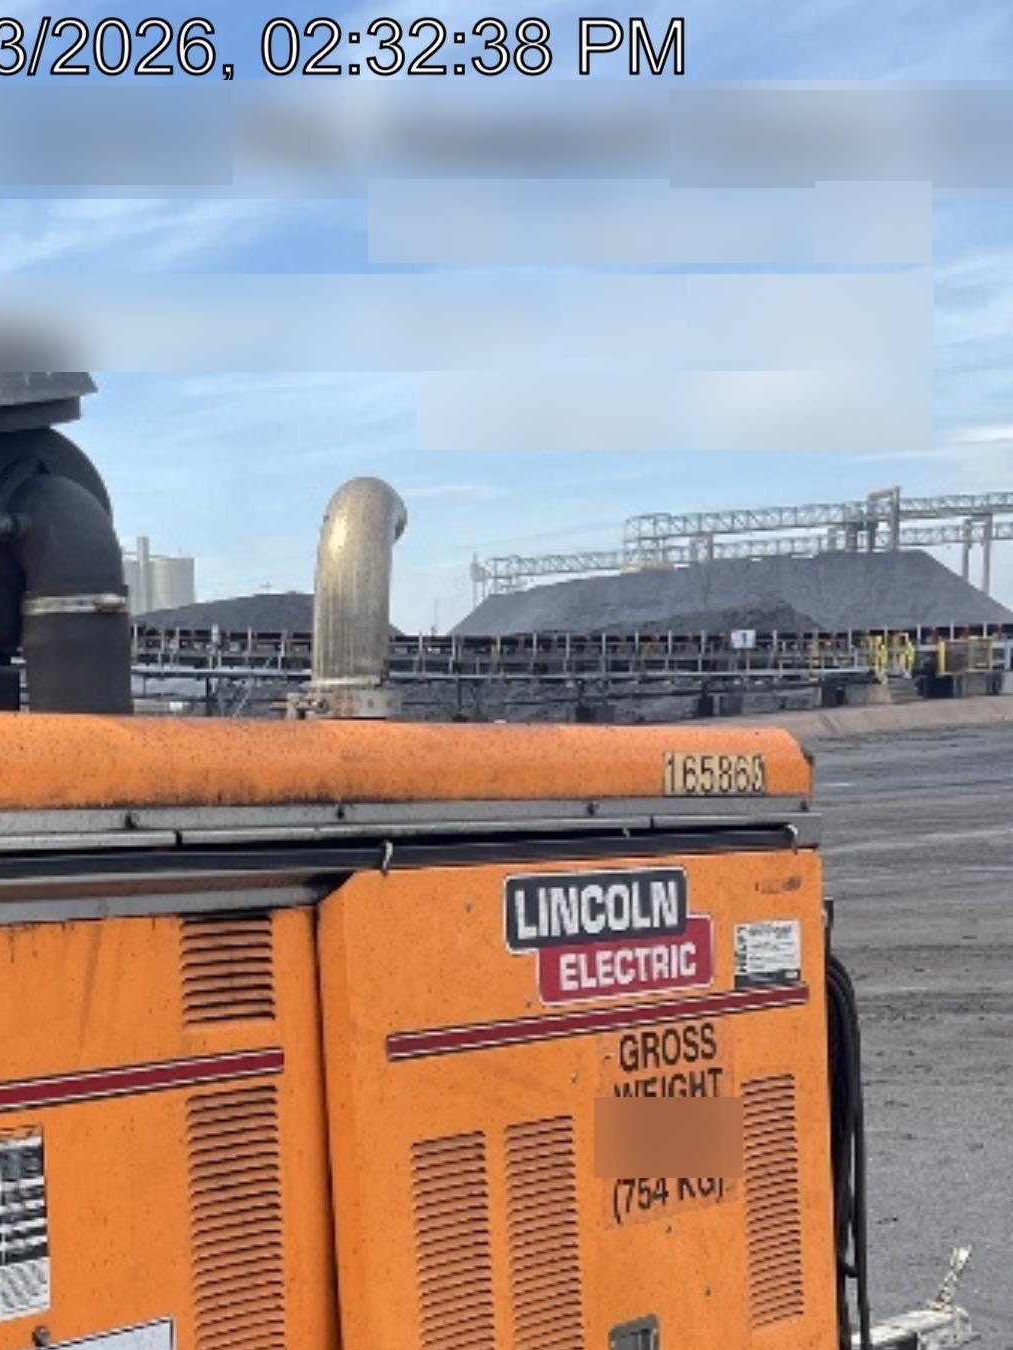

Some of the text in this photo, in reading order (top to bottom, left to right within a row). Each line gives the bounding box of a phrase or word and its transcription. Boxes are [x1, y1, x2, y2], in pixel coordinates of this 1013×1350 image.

[514, 879, 679, 940] LINCOLN
[560, 941, 697, 992] ELECTRIC
[618, 1022, 718, 1072] GROSS
